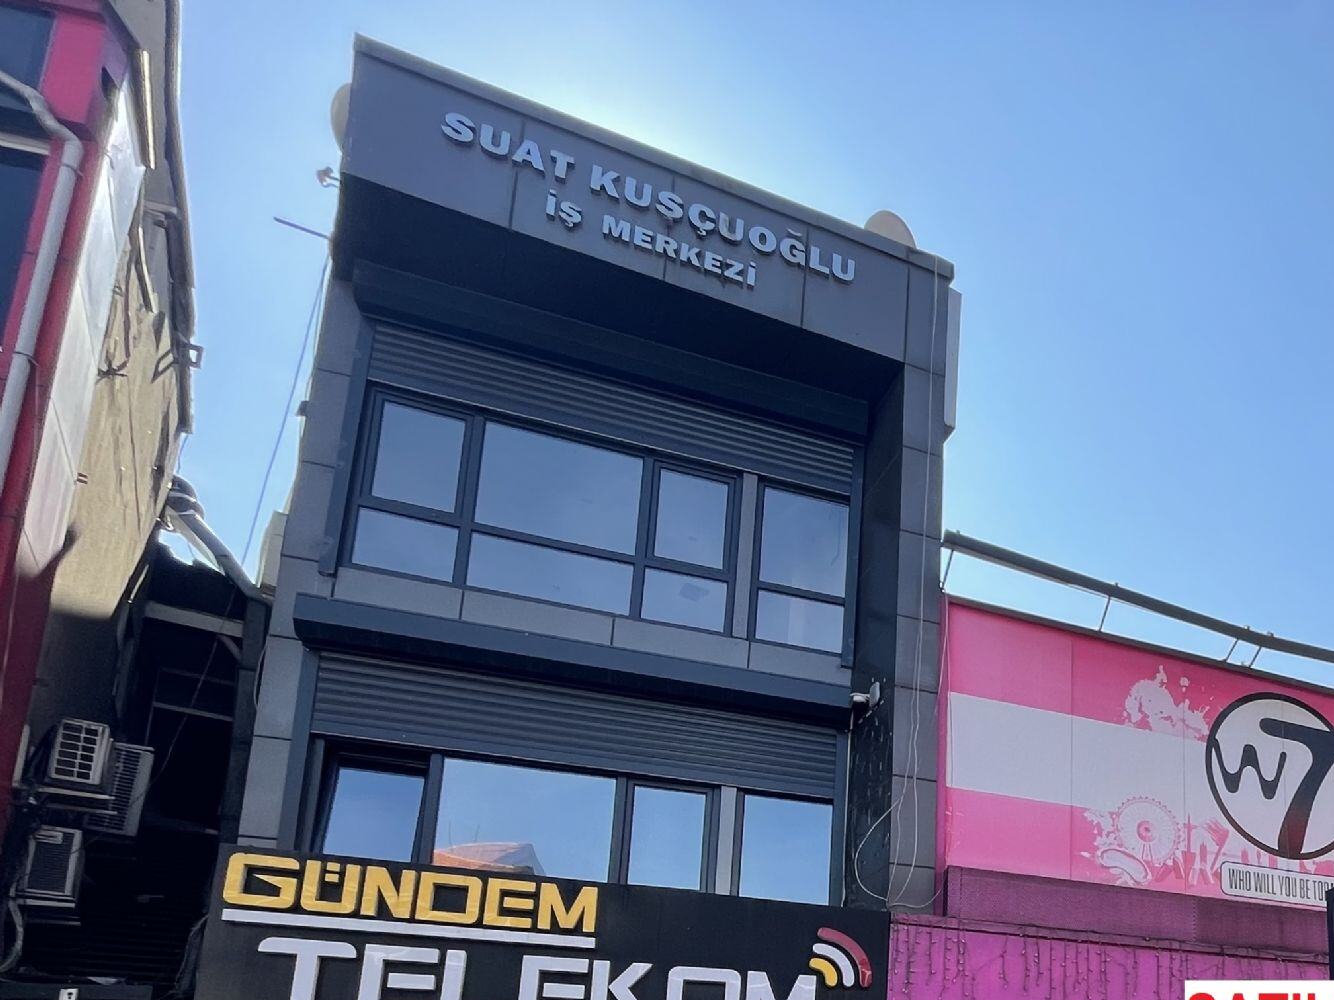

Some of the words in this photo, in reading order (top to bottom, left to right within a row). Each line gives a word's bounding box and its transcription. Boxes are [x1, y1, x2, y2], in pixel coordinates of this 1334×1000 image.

[441, 112, 575, 180] SUAT
[590, 164, 856, 282] KUŞÇUOĞLU
[545, 189, 583, 228] İŞ
[602, 214, 757, 287] MERKEZİ
[223, 852, 597, 932] GÜNDEM
[1228, 868, 1251, 892] WHO
[1253, 871, 1276, 895] WILL
[1277, 875, 1297, 898] YOU
[1299, 878, 1310, 900] BE
